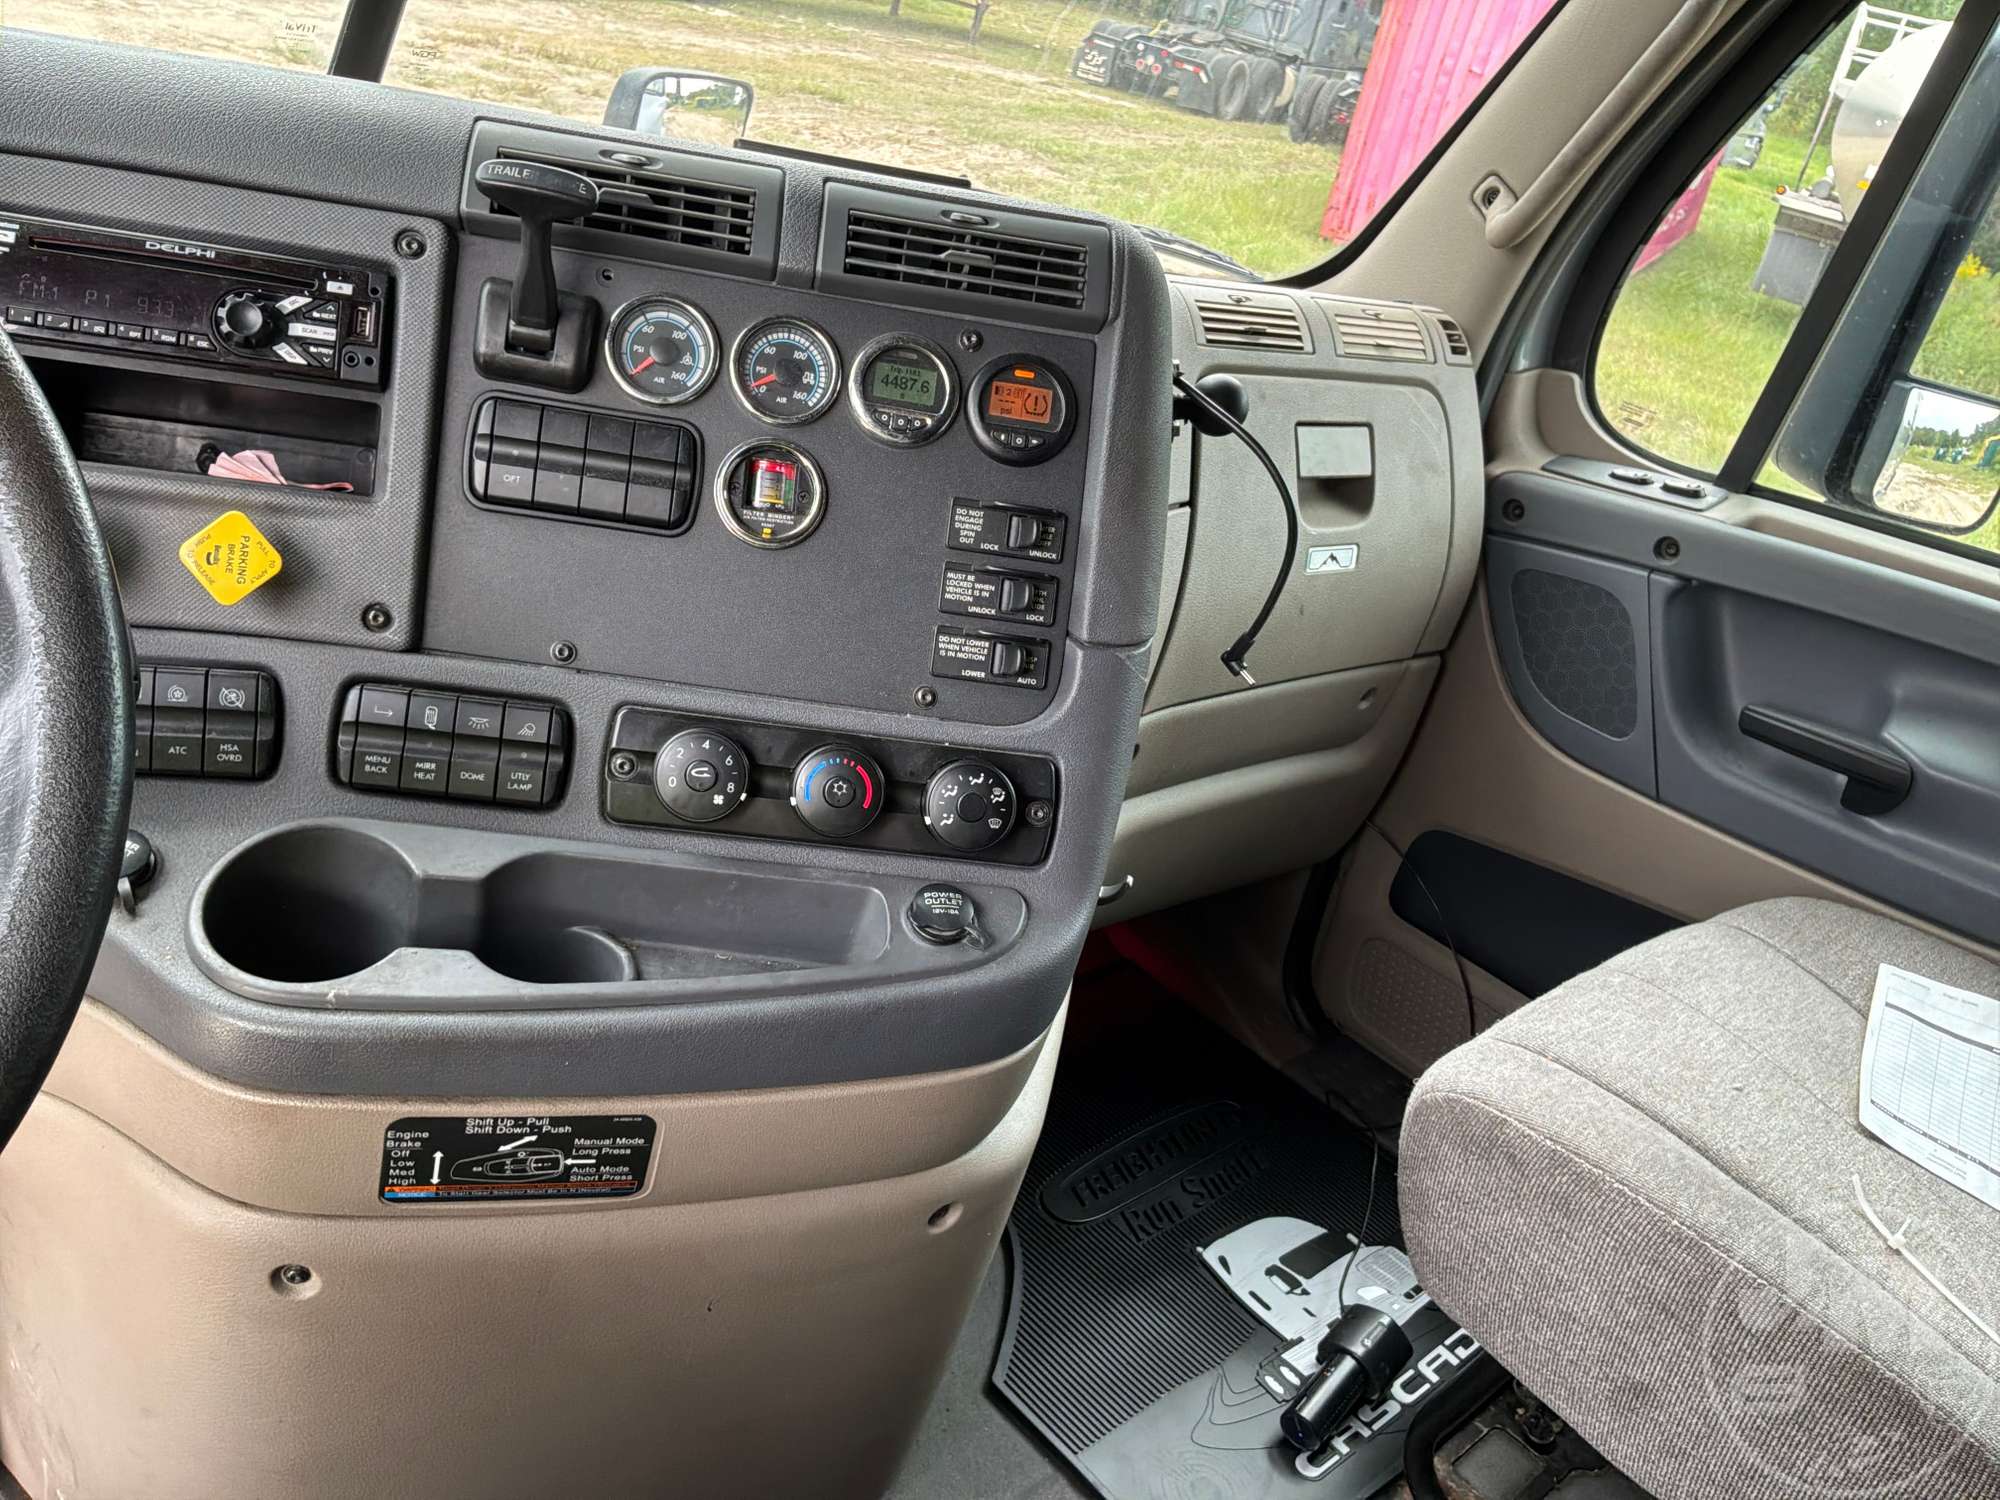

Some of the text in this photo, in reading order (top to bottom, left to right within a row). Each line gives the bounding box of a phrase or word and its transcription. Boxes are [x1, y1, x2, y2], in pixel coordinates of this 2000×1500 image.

[145, 241, 216, 258] DELPHI
[641, 325, 655, 335] 60
[671, 330, 687, 341] 100
[633, 345, 645, 353] PSI
[764, 346, 777, 356] 60
[793, 350, 808, 361] 100
[756, 366, 767, 374] PSI
[653, 376, 666, 384] AIR
[671, 371, 686, 381] 160
[881, 374, 930, 394] 4487.6
[759, 384, 767, 394] 0
[776, 396, 788, 404] AIR
[792, 390, 807, 401] 160
[969, 509, 984, 517] NOT
[955, 515, 984, 524] ENGAGE
[955, 522, 982, 531] DURING
[959, 536, 974, 544] OUT
[981, 542, 999, 551] LOCK
[225, 543, 236, 574] BRAKE
[1029, 550, 1056, 559] UNLOCK
[236, 535, 251, 585] PARKING
[947, 572, 966, 580] MUST
[946, 580, 995, 591] LOCKED WHEN
[945, 586, 972, 595] VEHICLE
[944, 593, 973, 602] MOTION
[968, 606, 996, 615] UNLOCK
[1026, 614, 1044, 622] LOCK
[966, 640, 989, 648] LOWER
[938, 643, 987, 655] WHEN VEHICLE
[957, 653, 985, 661] MOTION
[961, 669, 985, 678] LOWER
[1017, 677, 1037, 685] AUTO
[220, 744, 239, 752] HSA
[702, 739, 710, 750] 4
[168, 746, 187, 755] ATC
[677, 747, 685, 759] 2
[216, 753, 242, 762] OVRD
[365, 755, 391, 764] MENU
[725, 754, 733, 767] 6
[364, 764, 388, 774] BACK
[415, 762, 436, 770] MIRR
[413, 772, 436, 781] HEAT
[460, 771, 486, 781] DOME
[511, 772, 531, 781] UTLY
[507, 782, 532, 791] LAMP
[668, 776, 676, 788] 0
[726, 782, 735, 794] 8
[924, 892, 962, 900] POWER
[925, 898, 963, 906] OUTLET
[466, 1118, 494, 1127] Shift
[497, 1118, 514, 1128] Up
[527, 1117, 549, 1126] Pull
[465, 1126, 493, 1135] Shift
[496, 1126, 530, 1134] Down
[542, 1125, 572, 1134] Push
[387, 1130, 429, 1140] Engine
[386, 1140, 422, 1148] Brake
[574, 1137, 645, 1145] Manual Mode
[391, 1149, 410, 1158] Off
[572, 1147, 631, 1156] Long Press
[390, 1159, 415, 1167] Low
[570, 1165, 630, 1173] Auto Mode
[388, 1178, 416, 1186] High
[569, 1174, 599, 1182] Short
[1121, 1200, 1183, 1242] Run
